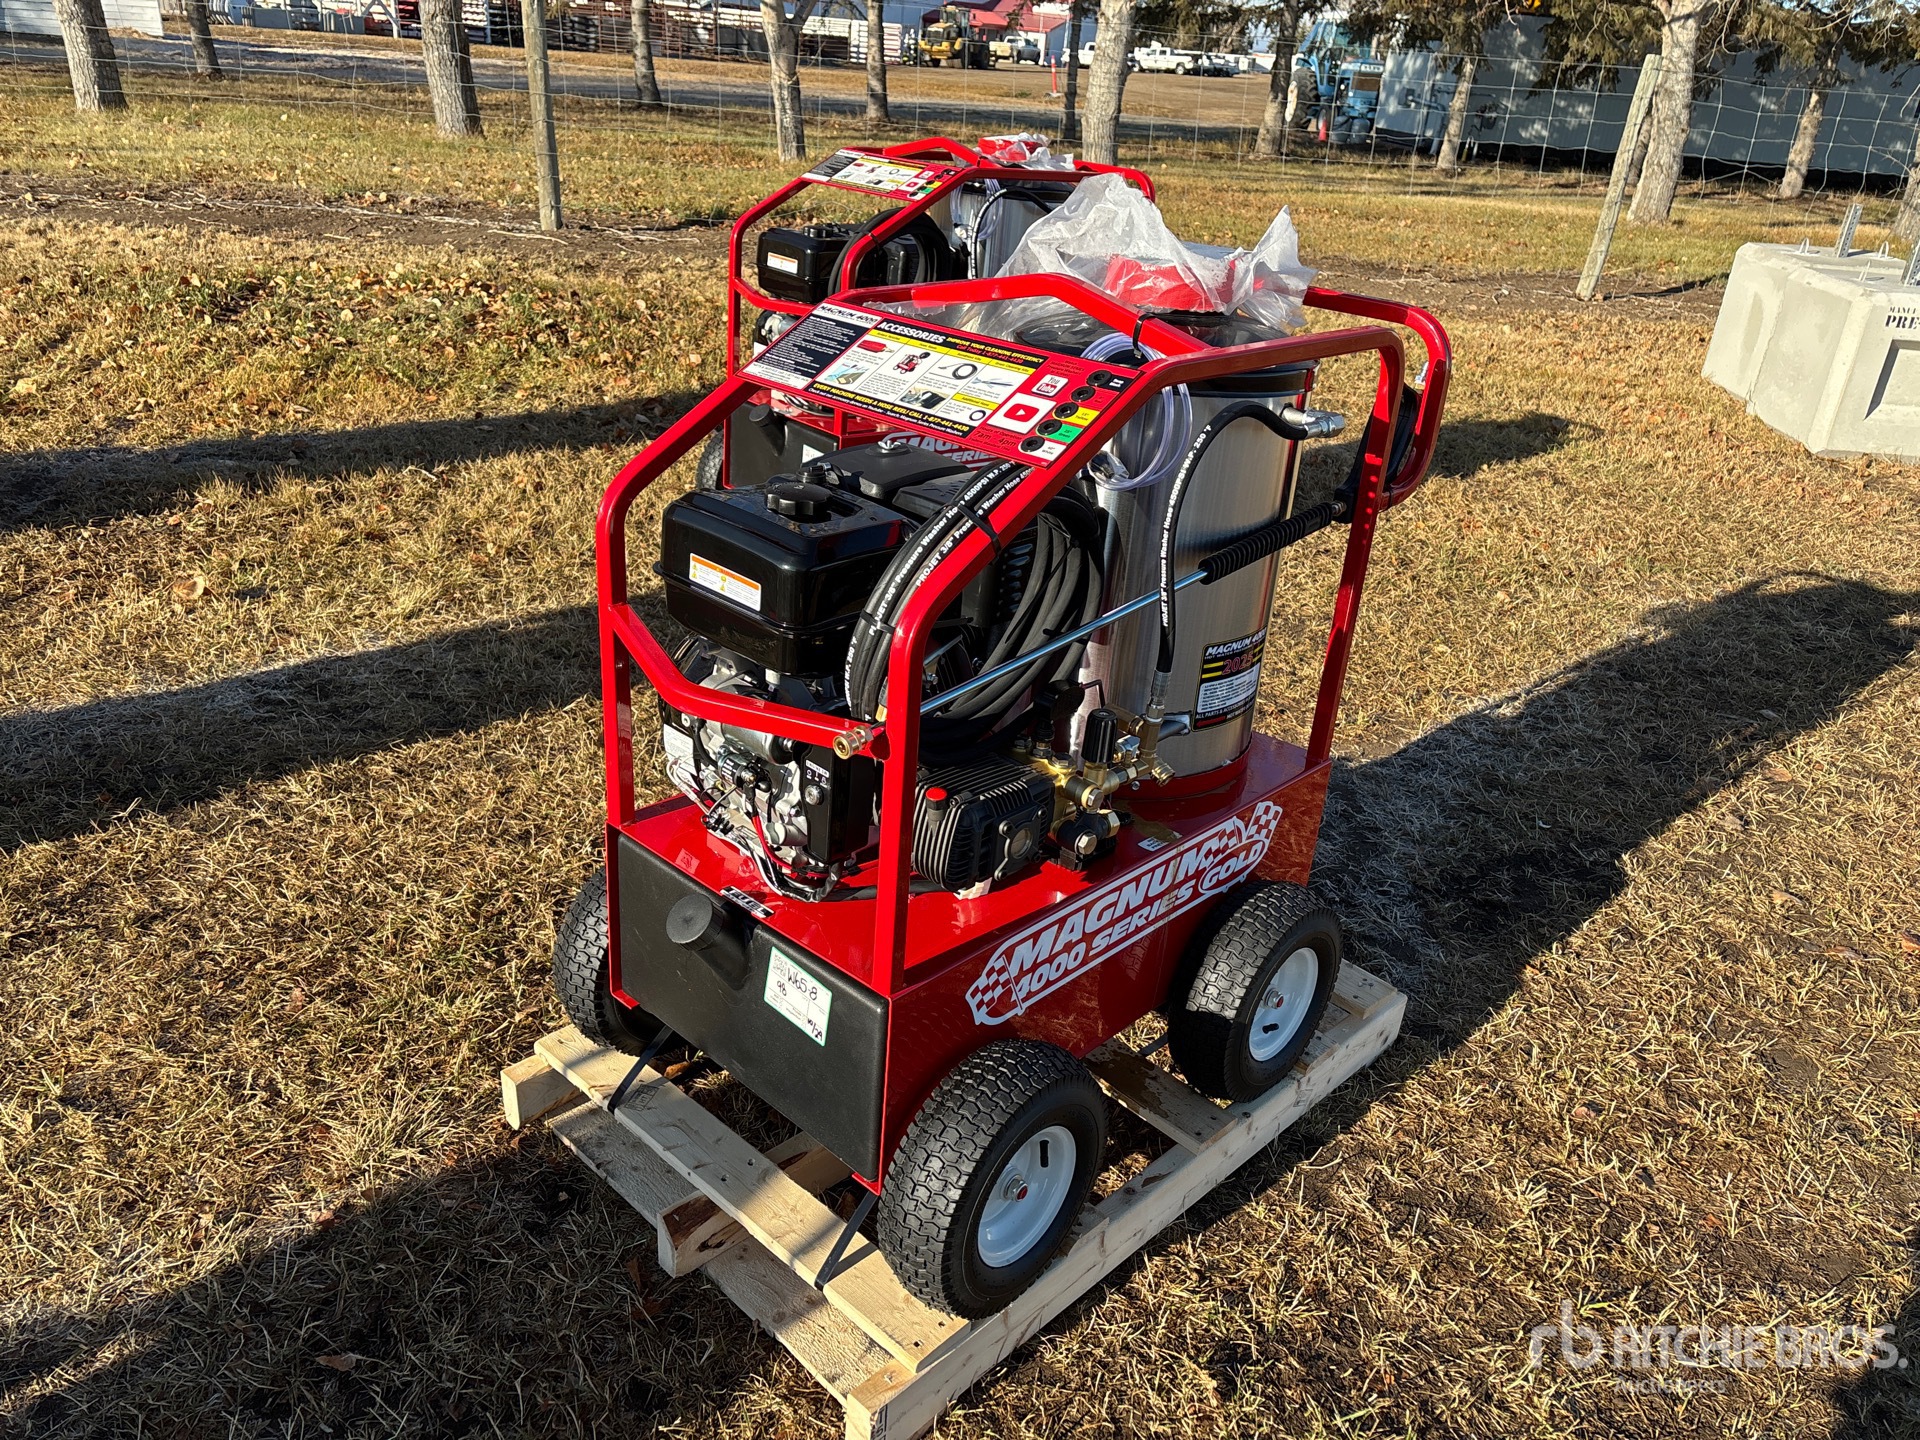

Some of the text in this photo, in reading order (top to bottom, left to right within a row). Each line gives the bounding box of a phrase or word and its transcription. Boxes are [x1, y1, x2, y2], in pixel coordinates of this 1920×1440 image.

[819, 305, 856, 318] MAGNUM
[875, 321, 948, 343] ACCESSORIES
[945, 337, 971, 345] IMPROVE
[983, 346, 1012, 355] CLEANING
[1010, 352, 1044, 363] EFFICIENCY
[1037, 383, 1057, 393] Tube
[812, 382, 832, 391] EVERY
[828, 387, 856, 398] MACHINE
[853, 394, 874, 403] NEEDS
[876, 401, 894, 409] HOSE
[891, 405, 910, 414] REEL!
[907, 410, 924, 418] CALL
[898, 414, 918, 423] Magnum
[973, 430, 992, 440] 7am
[996, 437, 1017, 448] 4pm
[1193, 432, 1207, 449] 250
[1168, 469, 1187, 506] 4500PSI
[1163, 507, 1173, 529] Hose
[885, 582, 896, 600] 3/8"
[894, 546, 923, 583] Pressure
[920, 517, 948, 547] Washer
[963, 477, 990, 501] 4500PSI
[987, 468, 1001, 480] W.P.
[999, 462, 1011, 472] 250
[916, 552, 941, 587] PROJET
[940, 536, 954, 554] 3/8"
[982, 487, 1006, 510] Washer
[1003, 477, 1021, 491] Hose
[1160, 529, 1169, 558] Washer
[1161, 601, 1169, 627] PROJET
[847, 647, 856, 663] 250
[1205, 637, 1250, 657] MAGNUM
[1221, 651, 1254, 676] 2025
[1204, 709, 1220, 718] PARTS
[1008, 828, 1262, 977] MAGNUM GOLD
[1011, 879, 1194, 1001] 4000 SERIES
